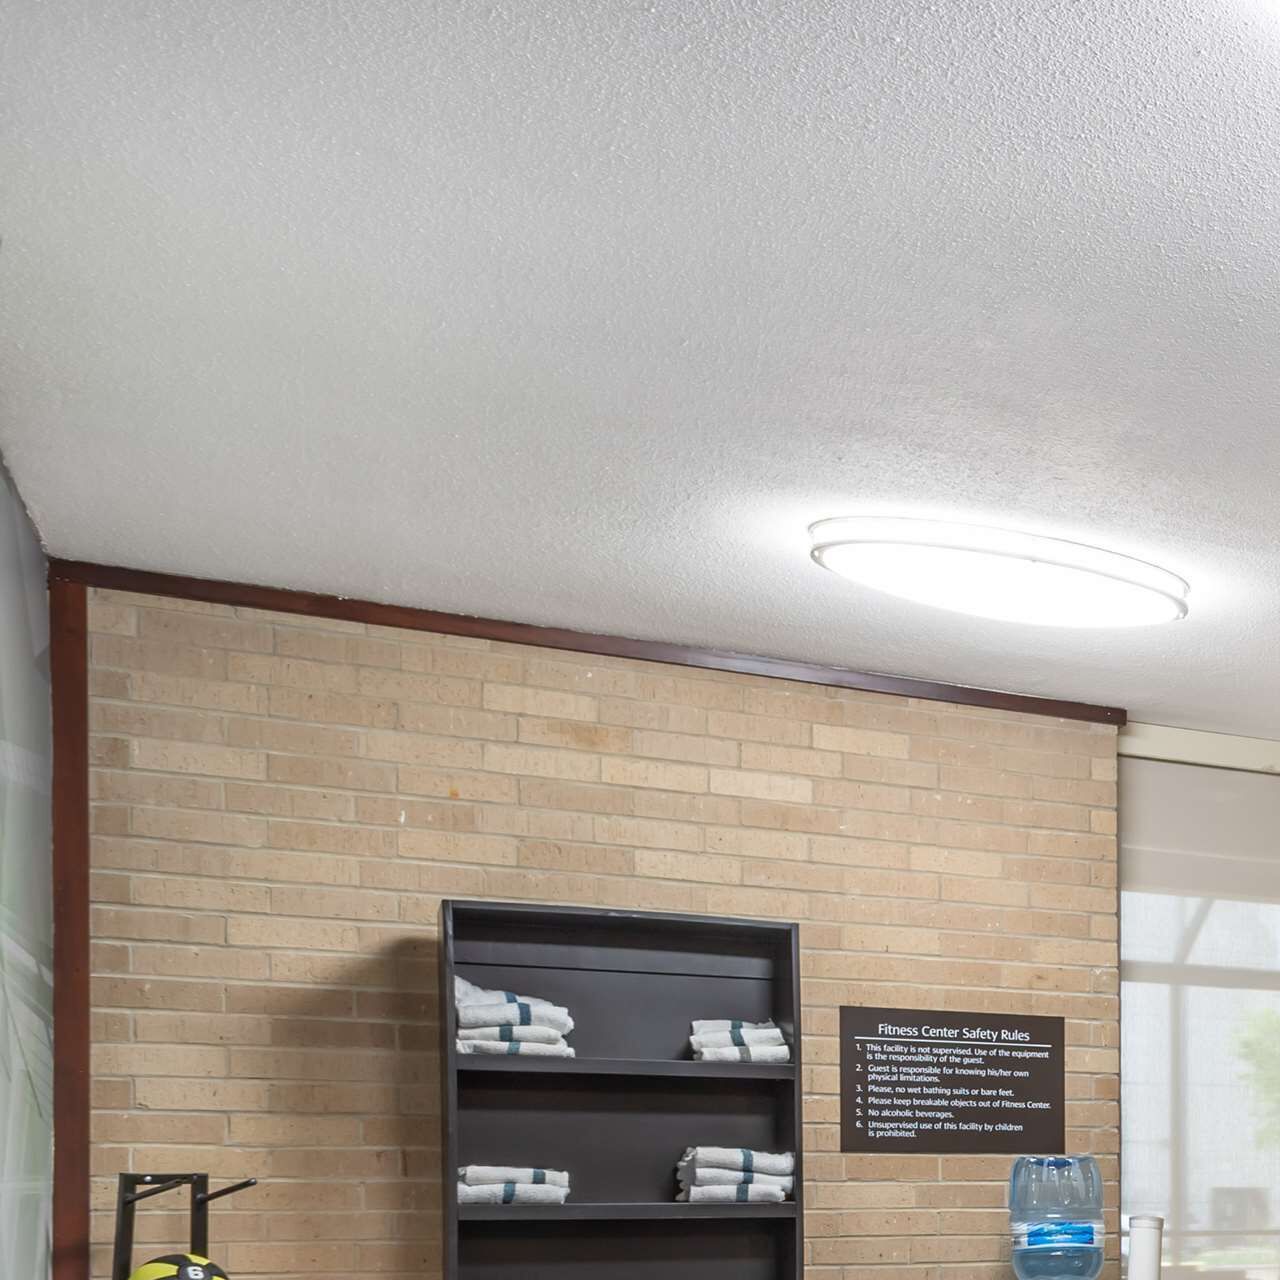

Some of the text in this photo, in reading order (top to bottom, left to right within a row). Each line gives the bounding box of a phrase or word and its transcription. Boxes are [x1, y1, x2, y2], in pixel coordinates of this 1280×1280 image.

[878, 1023, 1029, 1041] Fitness Center Safety Rules
[855, 1043, 861, 1051] 1.
[866, 1044, 882, 1052] This
[883, 1044, 908, 1054] facility
[910, 1045, 916, 1053] is
[932, 1046, 971, 1056] supervised.
[988, 1048, 997, 1056] of
[1011, 1049, 1048, 1059] equipment
[889, 1053, 937, 1063] responsibility
[962, 1056, 983, 1064] guest.
[867, 1064, 890, 1072] Guest
[899, 1065, 941, 1075] responsible
[955, 1067, 985, 1076] knowing
[867, 1073, 897, 1082] physical
[855, 1084, 862, 1092] 3.
[923, 1086, 950, 1095] bathing
[893, 1097, 909, 1106] keep
[912, 1098, 948, 1106] breakable
[949, 1099, 976, 1107] objects
[1026, 1100, 1050, 1108] Center.
[915, 1110, 953, 1118] beverages.
[868, 1121, 917, 1130] Unsupervised
[958, 1122, 983, 1131] facility
[984, 1123, 993, 1131] by
[876, 1130, 916, 1138] prohibited.
[187, 1266, 204, 1280] 6
